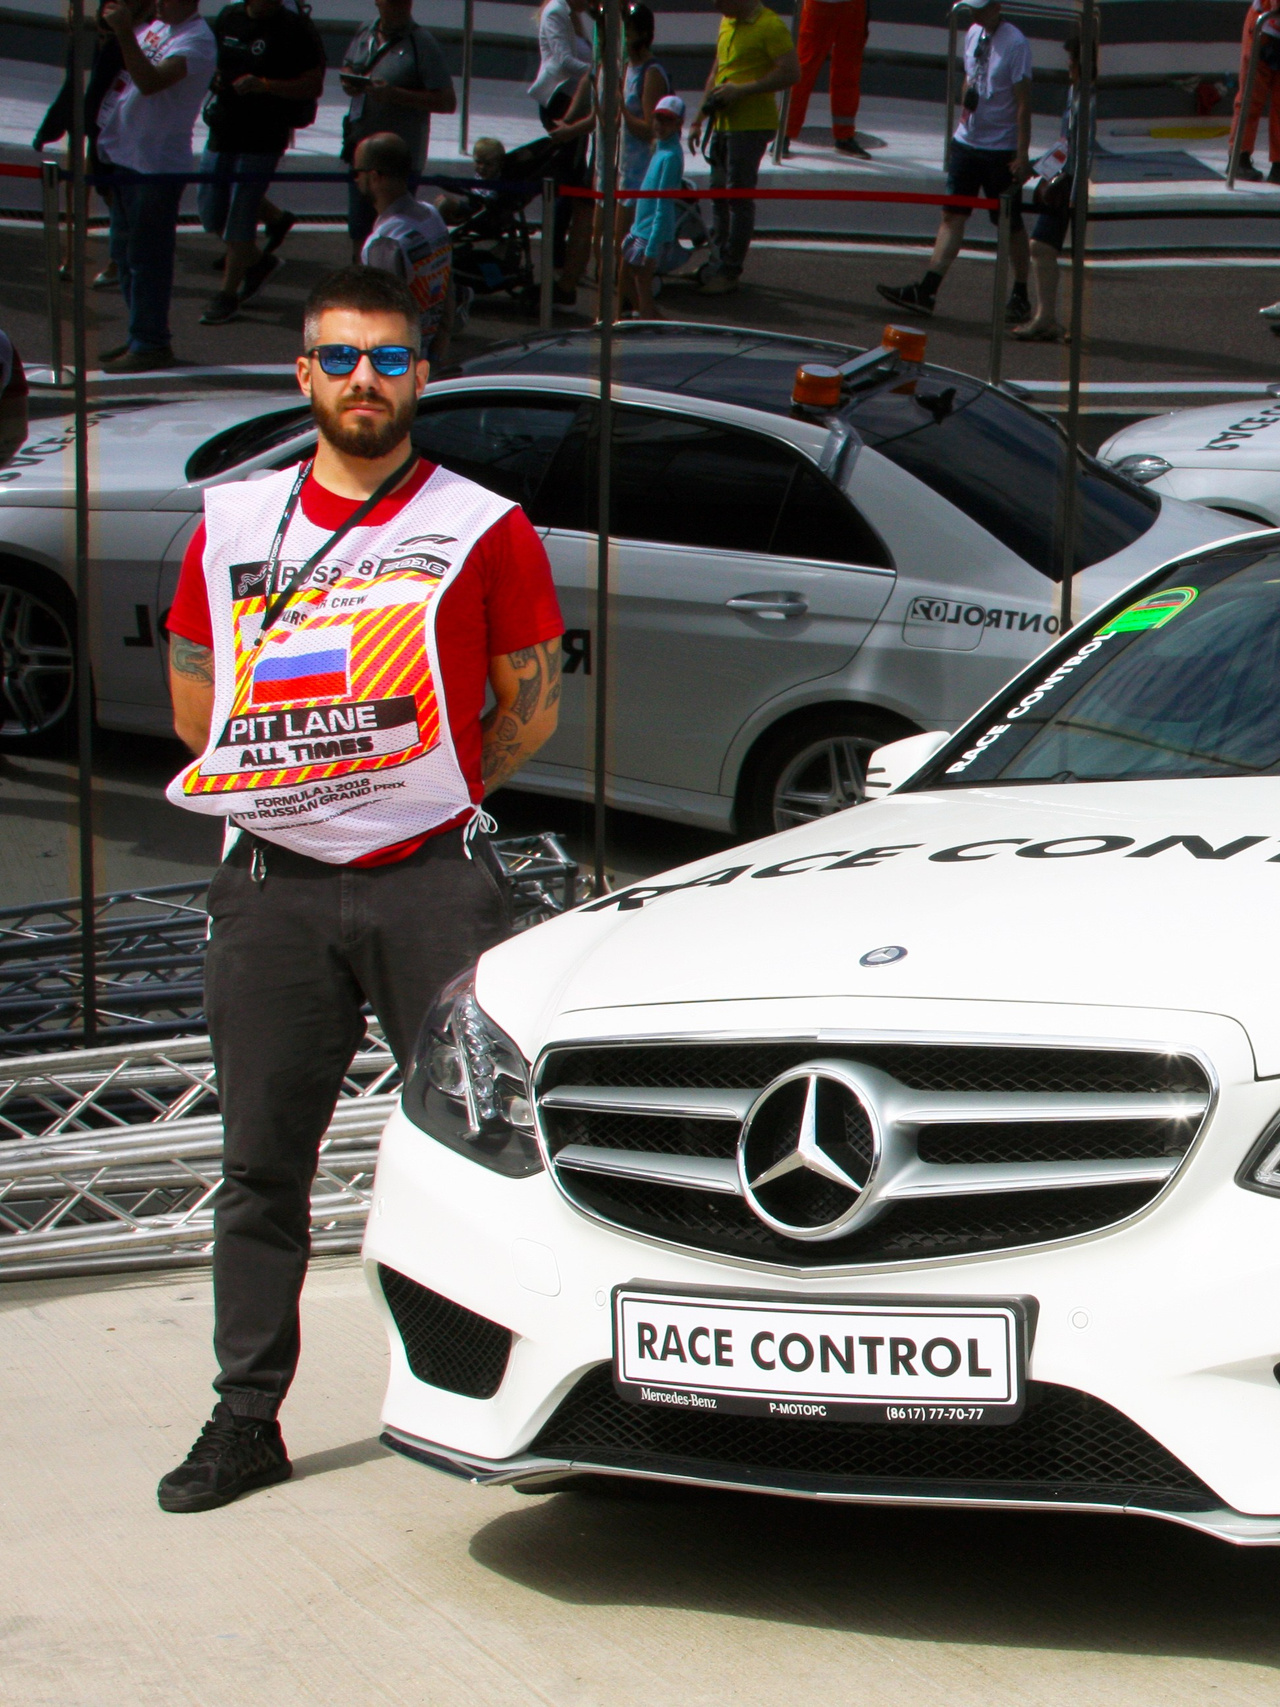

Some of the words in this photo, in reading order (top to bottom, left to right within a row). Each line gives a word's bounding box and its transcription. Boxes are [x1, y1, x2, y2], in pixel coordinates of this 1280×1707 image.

[331, 595, 369, 609] CREW
[945, 723, 1012, 773] RACE
[1006, 630, 1118, 719] CONTROL
[229, 715, 278, 743] PIT
[284, 704, 378, 738] LANE
[239, 747, 286, 768] ALL
[288, 735, 375, 763] TIMES
[254, 785, 323, 809] FORMULA
[324, 785, 333, 794] 1
[335, 778, 371, 792] 2018
[258, 800, 319, 819] RUSSIAN
[319, 786, 371, 806] GRAND
[373, 780, 407, 793] PRIX
[576, 843, 927, 912] RACE
[637, 1321, 734, 1368] RACE
[750, 1330, 992, 1378] CONTROL
[640, 1387, 717, 1409] Mercedes-Benz
[885, 1406, 927, 1422] (8617)
[928, 1407, 984, 1421] 77-70-77
